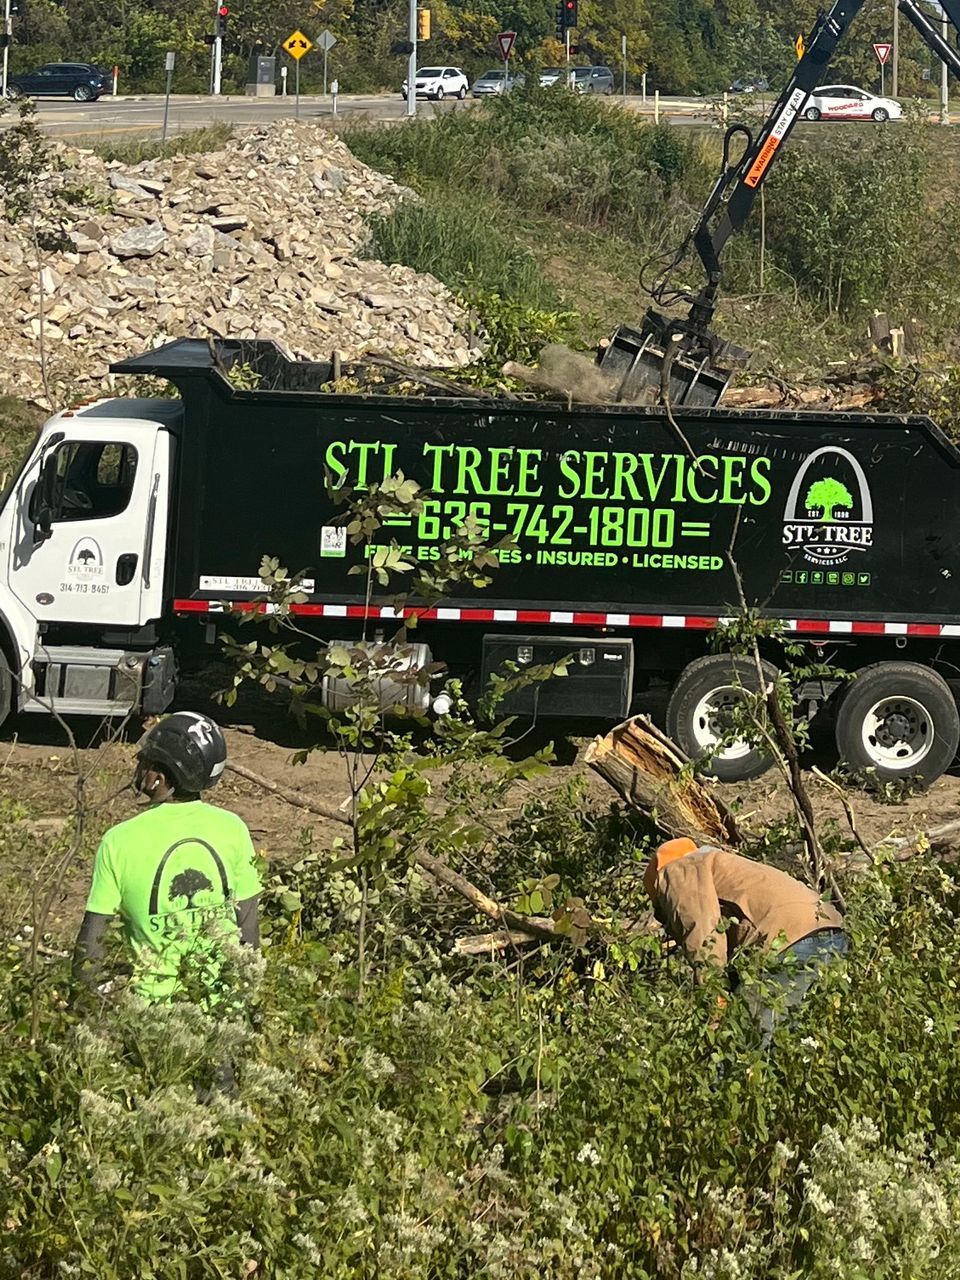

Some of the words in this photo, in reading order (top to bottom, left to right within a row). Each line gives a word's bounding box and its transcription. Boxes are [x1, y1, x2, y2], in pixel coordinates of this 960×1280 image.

[755, 137, 777, 172] WARNING
[775, 117, 788, 136] STAY
[786, 92, 802, 117] CLEAR
[423, 442, 543, 497] TREE
[558, 450, 771, 505] SERVICES
[364, 544, 413, 559] FE
[417, 546, 522, 564] ESMES
[537, 550, 618, 567] INSURED
[633, 553, 723, 570] LICENSED
[782, 524, 819, 544] STL
[823, 525, 873, 546] TREE
